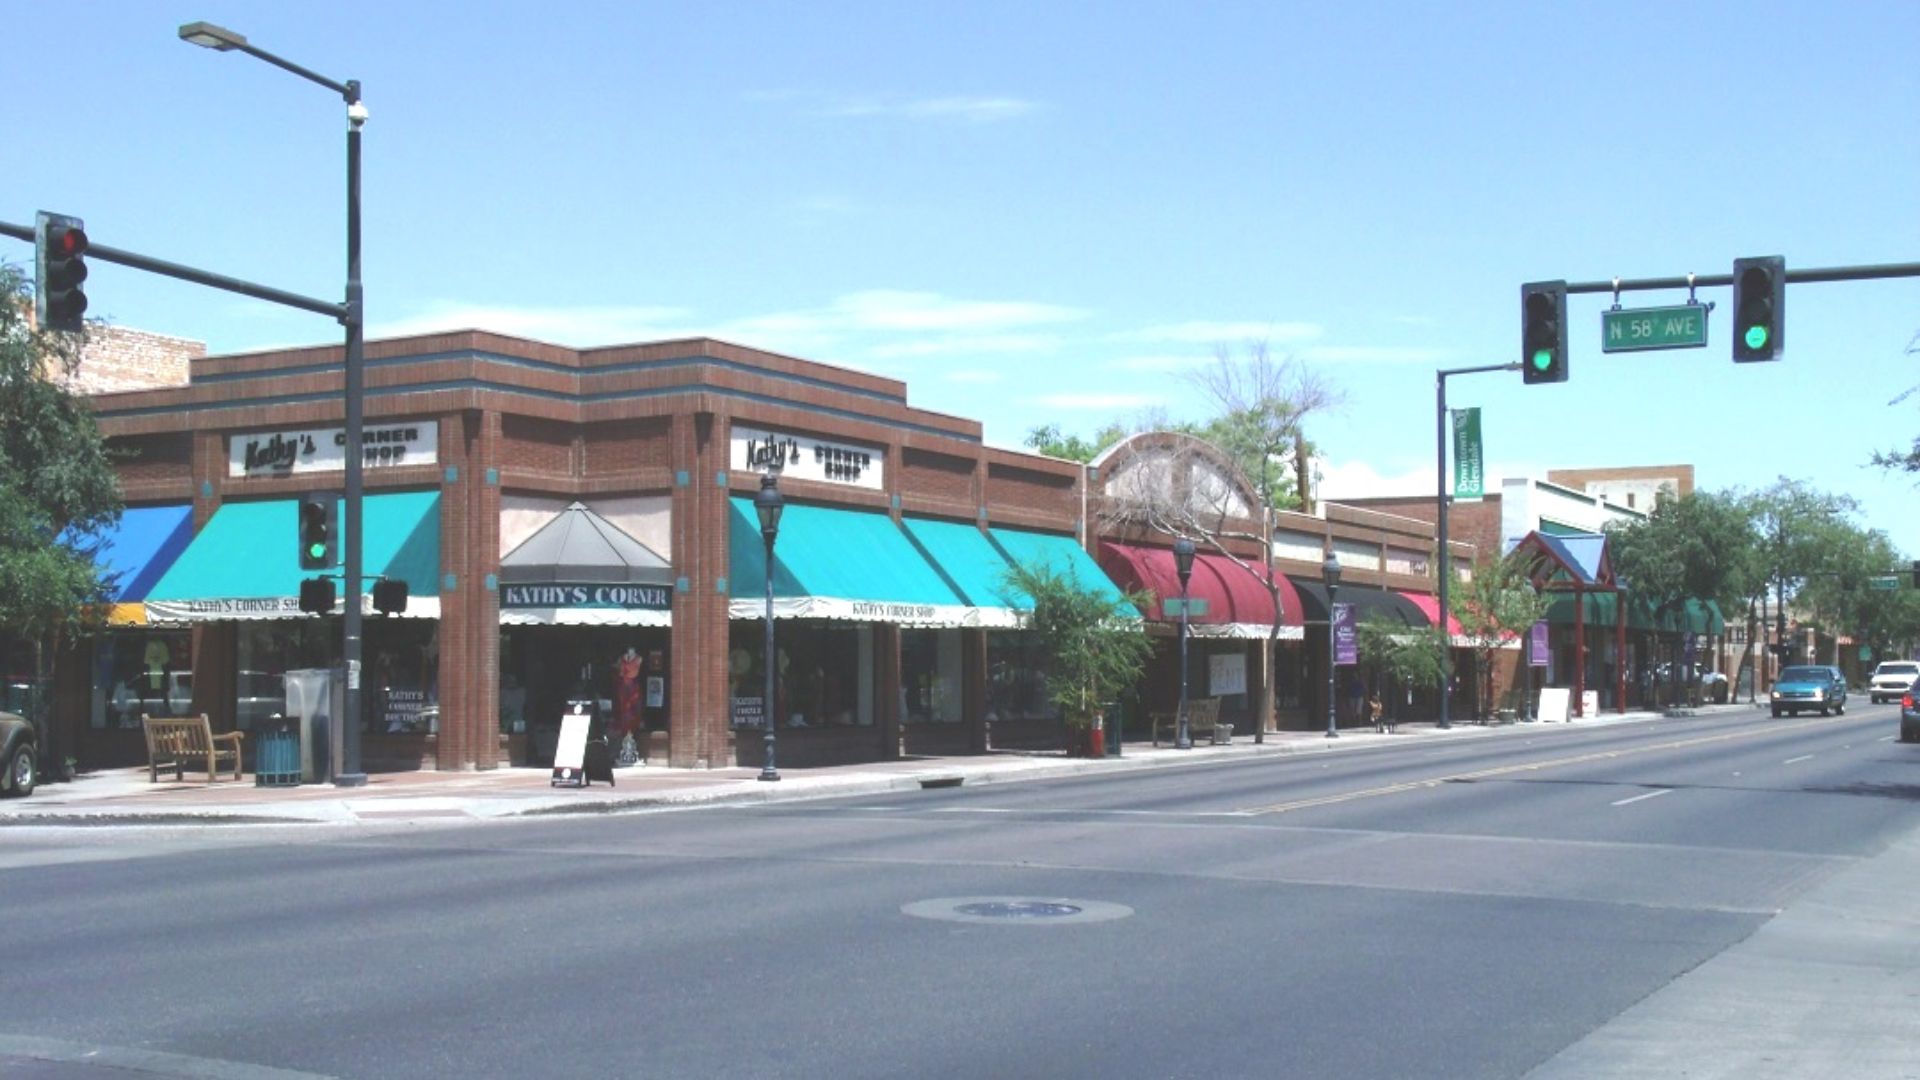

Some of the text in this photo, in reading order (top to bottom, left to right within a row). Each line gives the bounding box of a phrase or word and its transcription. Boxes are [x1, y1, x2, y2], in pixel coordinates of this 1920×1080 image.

[1611, 322, 1622, 339] N
[1665, 317, 1696, 336] AVE
[334, 427, 418, 446] CRNER
[245, 433, 316, 470] Kathy's
[746, 432, 800, 471] Kathy's
[1457, 432, 1468, 492] Downtown
[1469, 441, 1480, 493] Glendale
[235, 599, 278, 611] CORNER
[506, 586, 667, 605] KATHY'S CORNER
